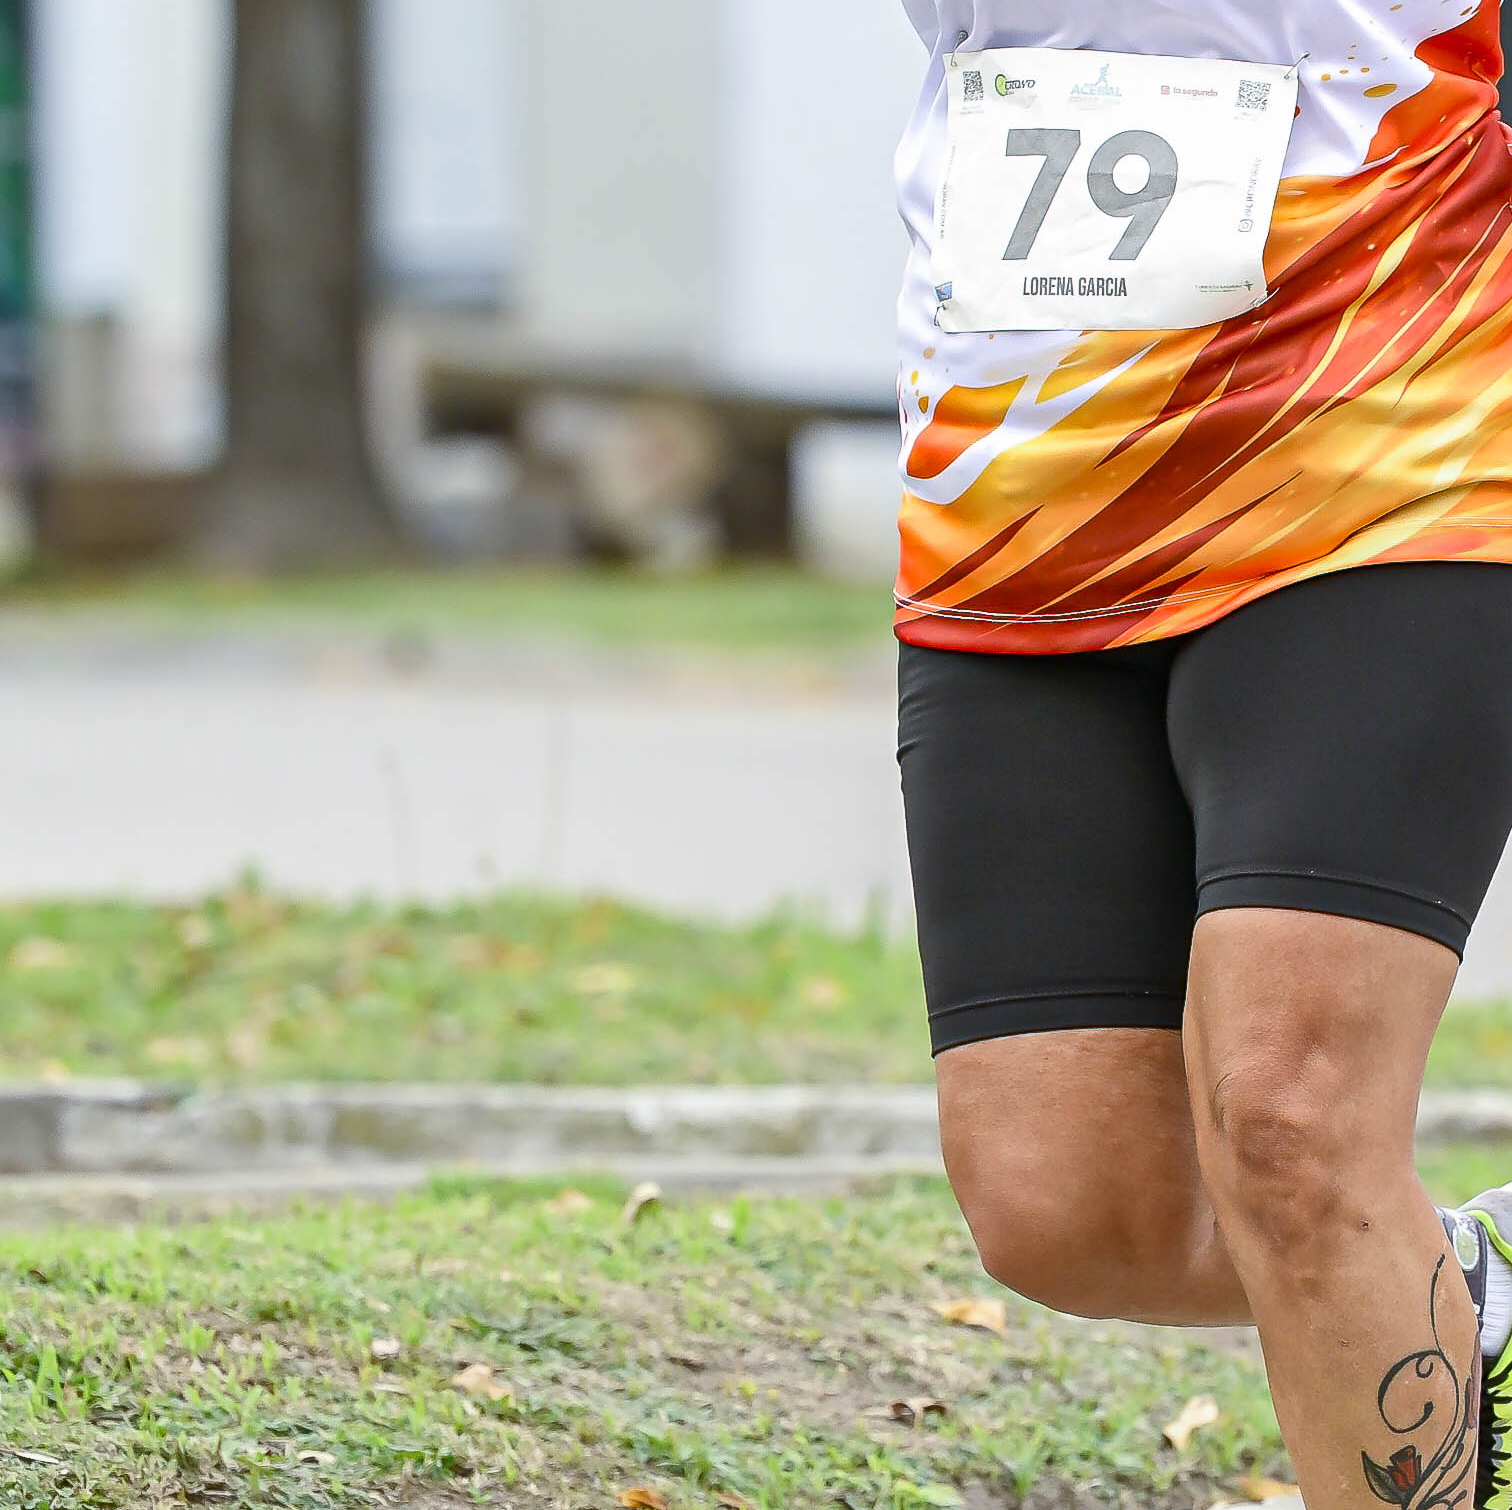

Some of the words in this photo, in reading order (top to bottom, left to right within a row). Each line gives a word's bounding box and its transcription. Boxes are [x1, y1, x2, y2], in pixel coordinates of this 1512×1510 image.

[1001, 128, 1179, 261] 79
[1022, 276, 1074, 296] LORENA
[1078, 276, 1128, 297] GARCIA
